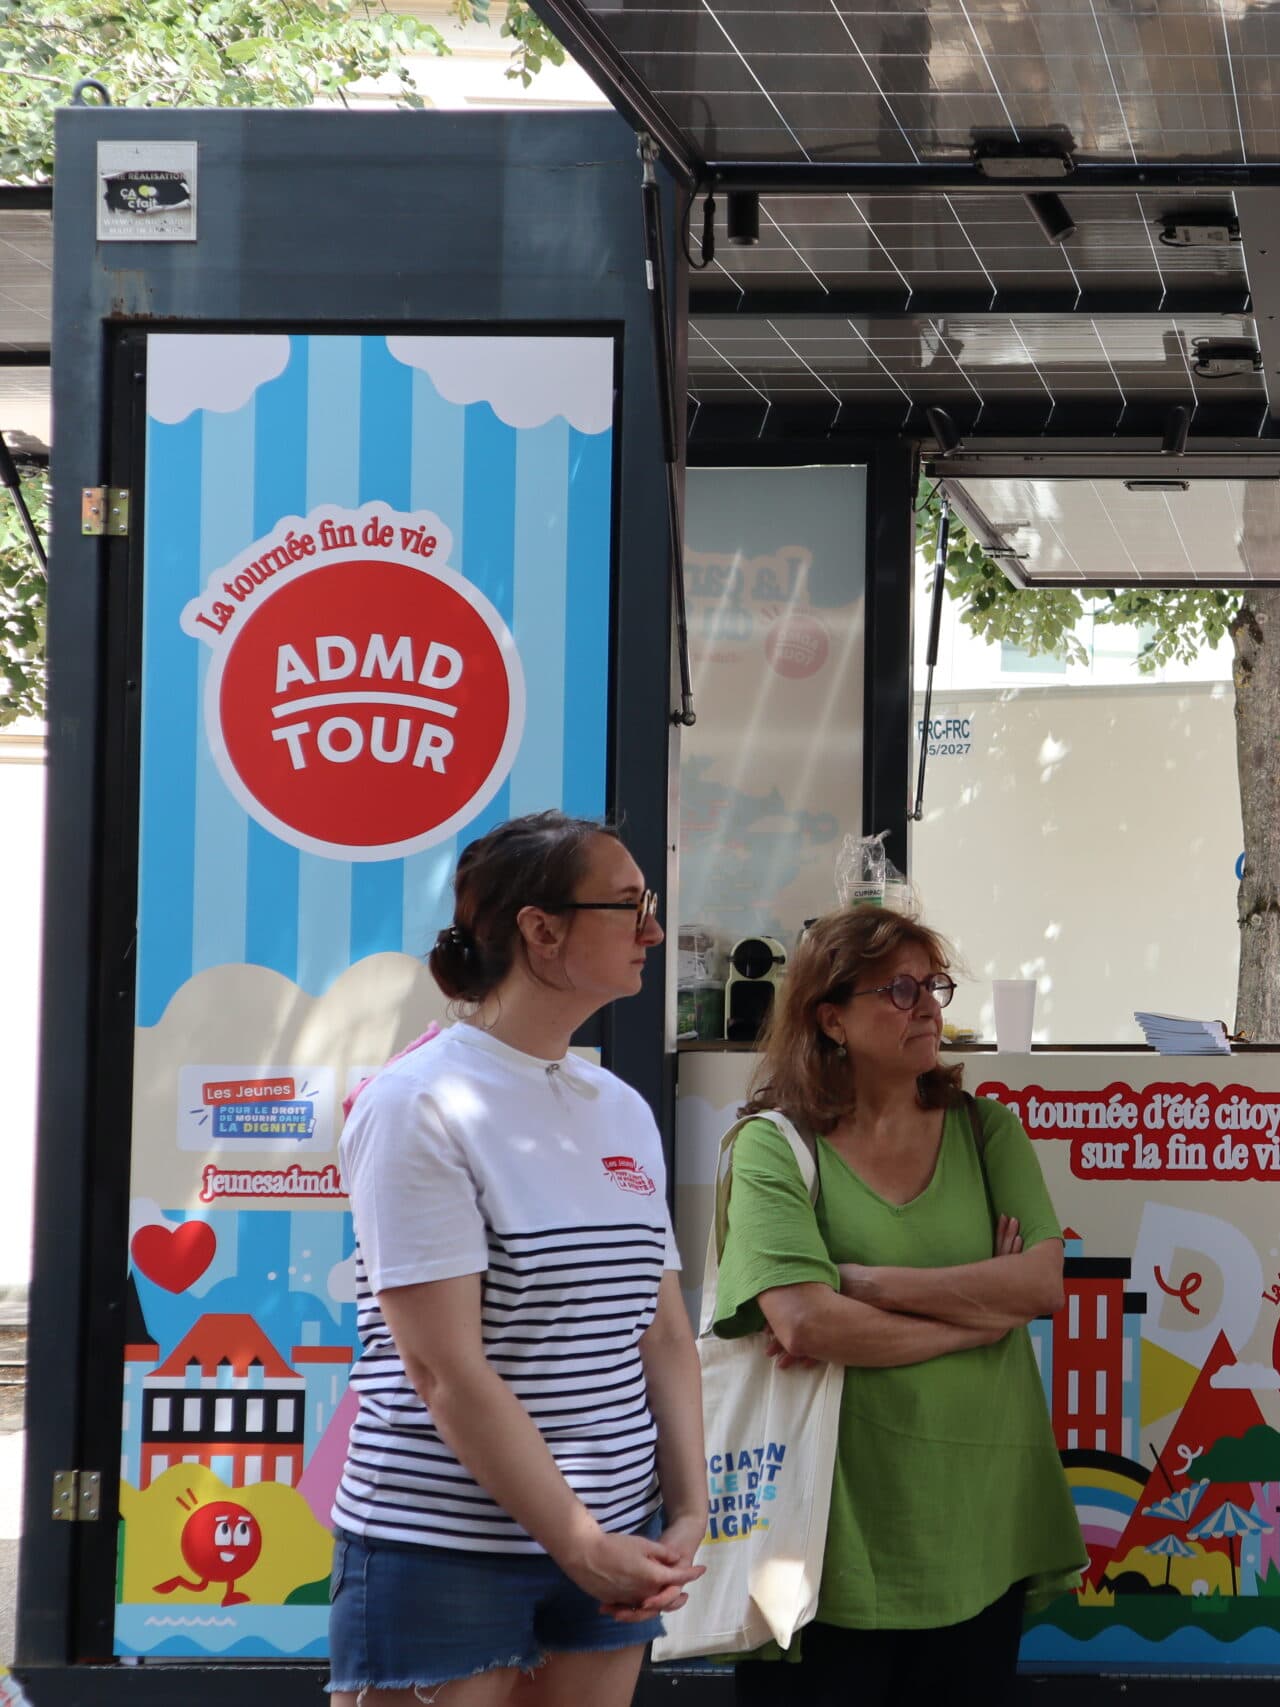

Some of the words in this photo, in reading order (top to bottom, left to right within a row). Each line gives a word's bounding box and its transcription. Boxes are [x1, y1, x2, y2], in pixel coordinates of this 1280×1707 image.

[195, 600, 235, 635] La
[223, 531, 316, 602] tournée
[318, 519, 357, 551] fin
[361, 517, 393, 547] de
[401, 525, 437, 558] vie
[275, 633, 463, 694] ADMD
[272, 716, 454, 774] TOUR
[206, 1087, 231, 1100] Les
[236, 1083, 291, 1098] Jeunes
[219, 1106, 252, 1114] POUR
[254, 1106, 268, 1114] LE
[271, 1106, 307, 1115] DROIT
[219, 1114, 233, 1122] DE
[235, 1114, 277, 1122] MOURIR
[278, 1114, 306, 1122] DANS
[219, 1123, 238, 1133] LA
[1026, 1093, 1138, 1129] tournée
[1081, 1142, 1130, 1169] sur
[1133, 1133, 1162, 1170] la
[1166, 1133, 1208, 1170] fin
[1213, 1134, 1249, 1171] de
